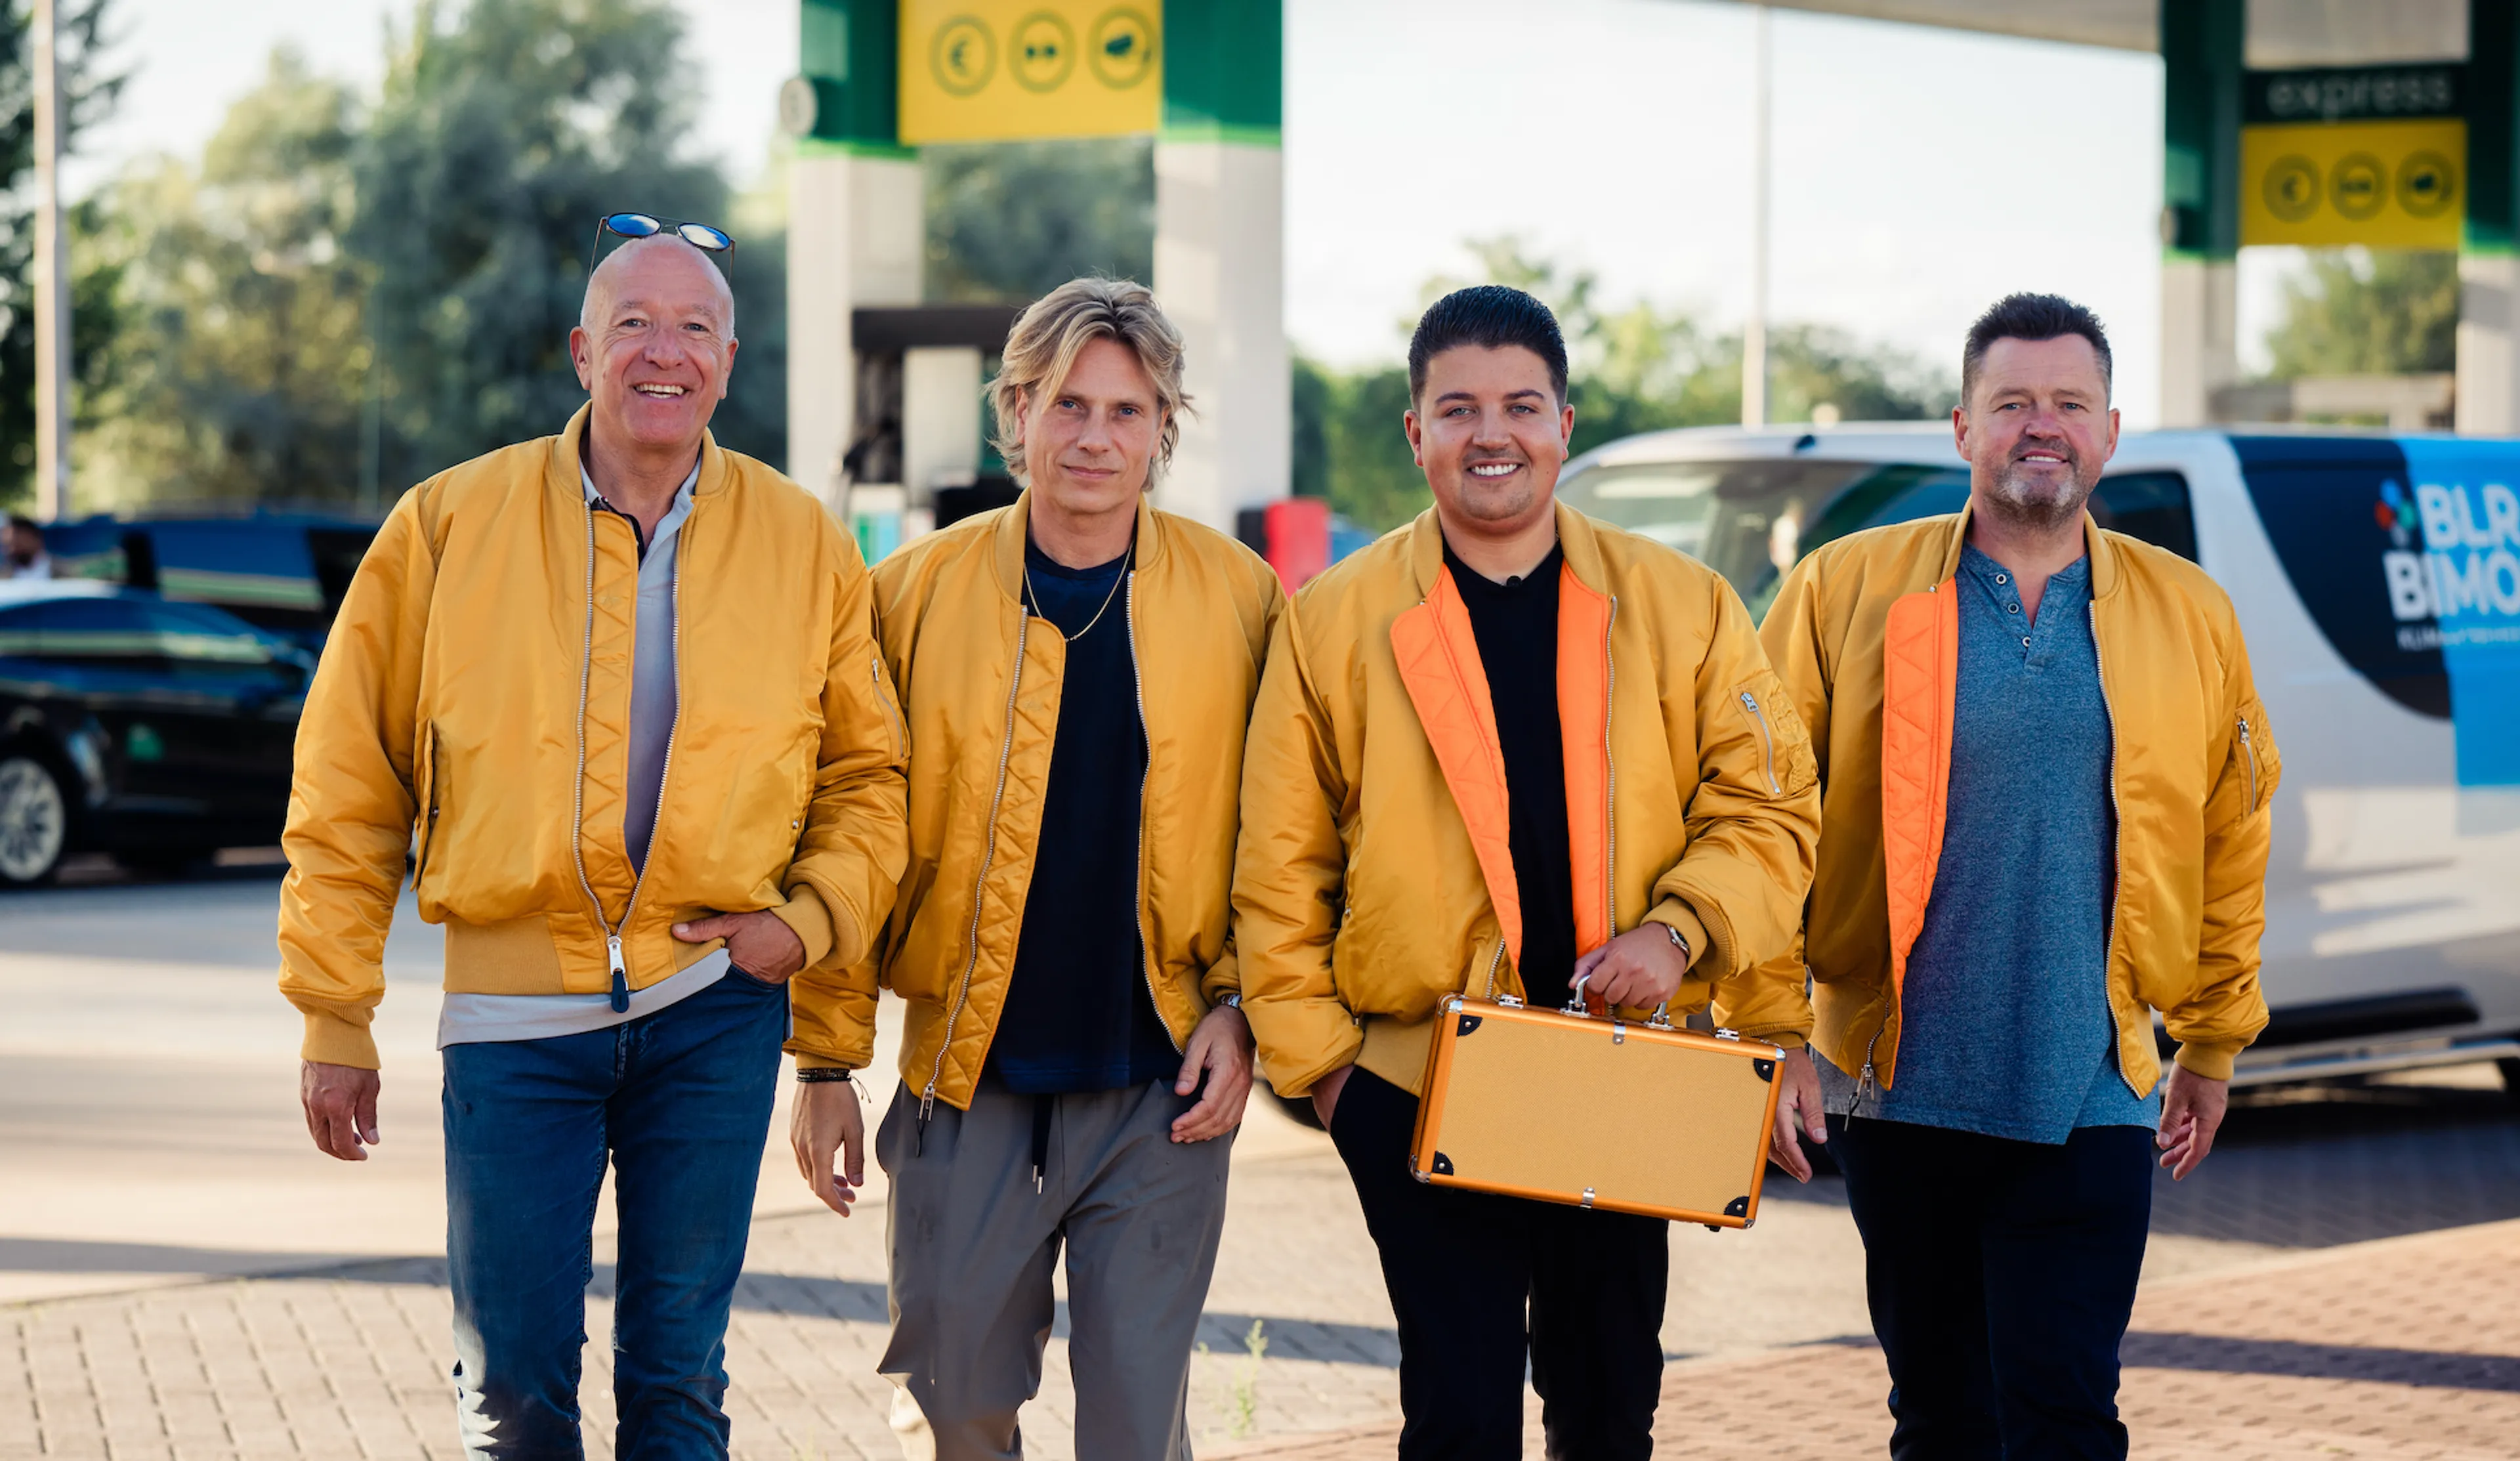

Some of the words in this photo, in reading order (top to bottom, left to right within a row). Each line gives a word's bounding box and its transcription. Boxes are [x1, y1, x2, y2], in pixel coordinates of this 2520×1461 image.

[2267, 75, 2452, 125] express
[2416, 484, 2520, 547] BLR
[2383, 550, 2520, 620] BIMO
